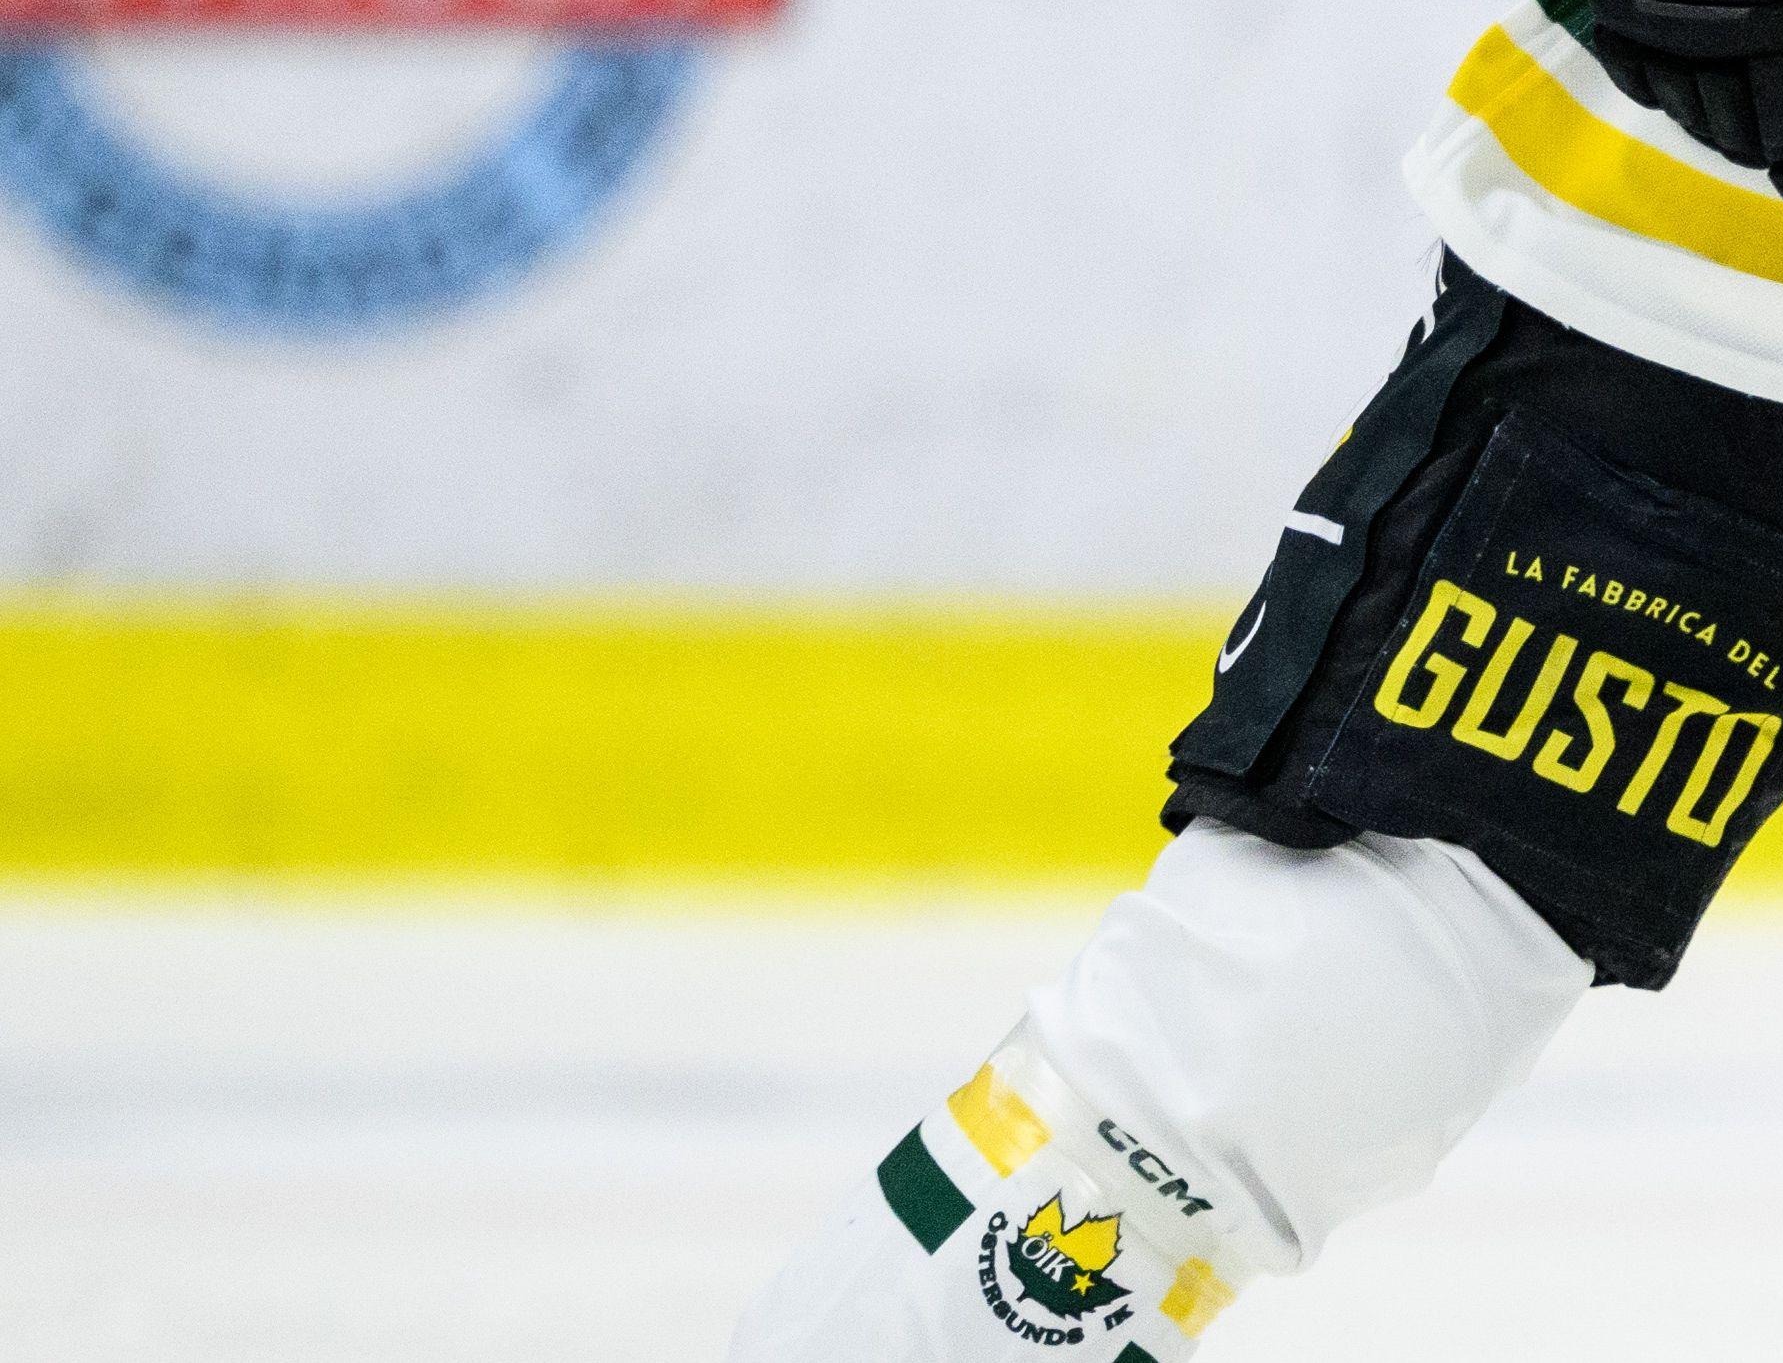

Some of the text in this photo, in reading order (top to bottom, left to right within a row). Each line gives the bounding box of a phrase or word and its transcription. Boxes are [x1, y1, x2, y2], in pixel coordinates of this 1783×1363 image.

[1505, 551, 1780, 690] LA FABBRICA DEL
[1374, 579, 1782, 848] GUSTO
[1098, 1118, 1214, 1216] CCM
[979, 1211, 1135, 1345] ÖSTERSUNDS IK
[1021, 1231, 1075, 1281] ÖIK
